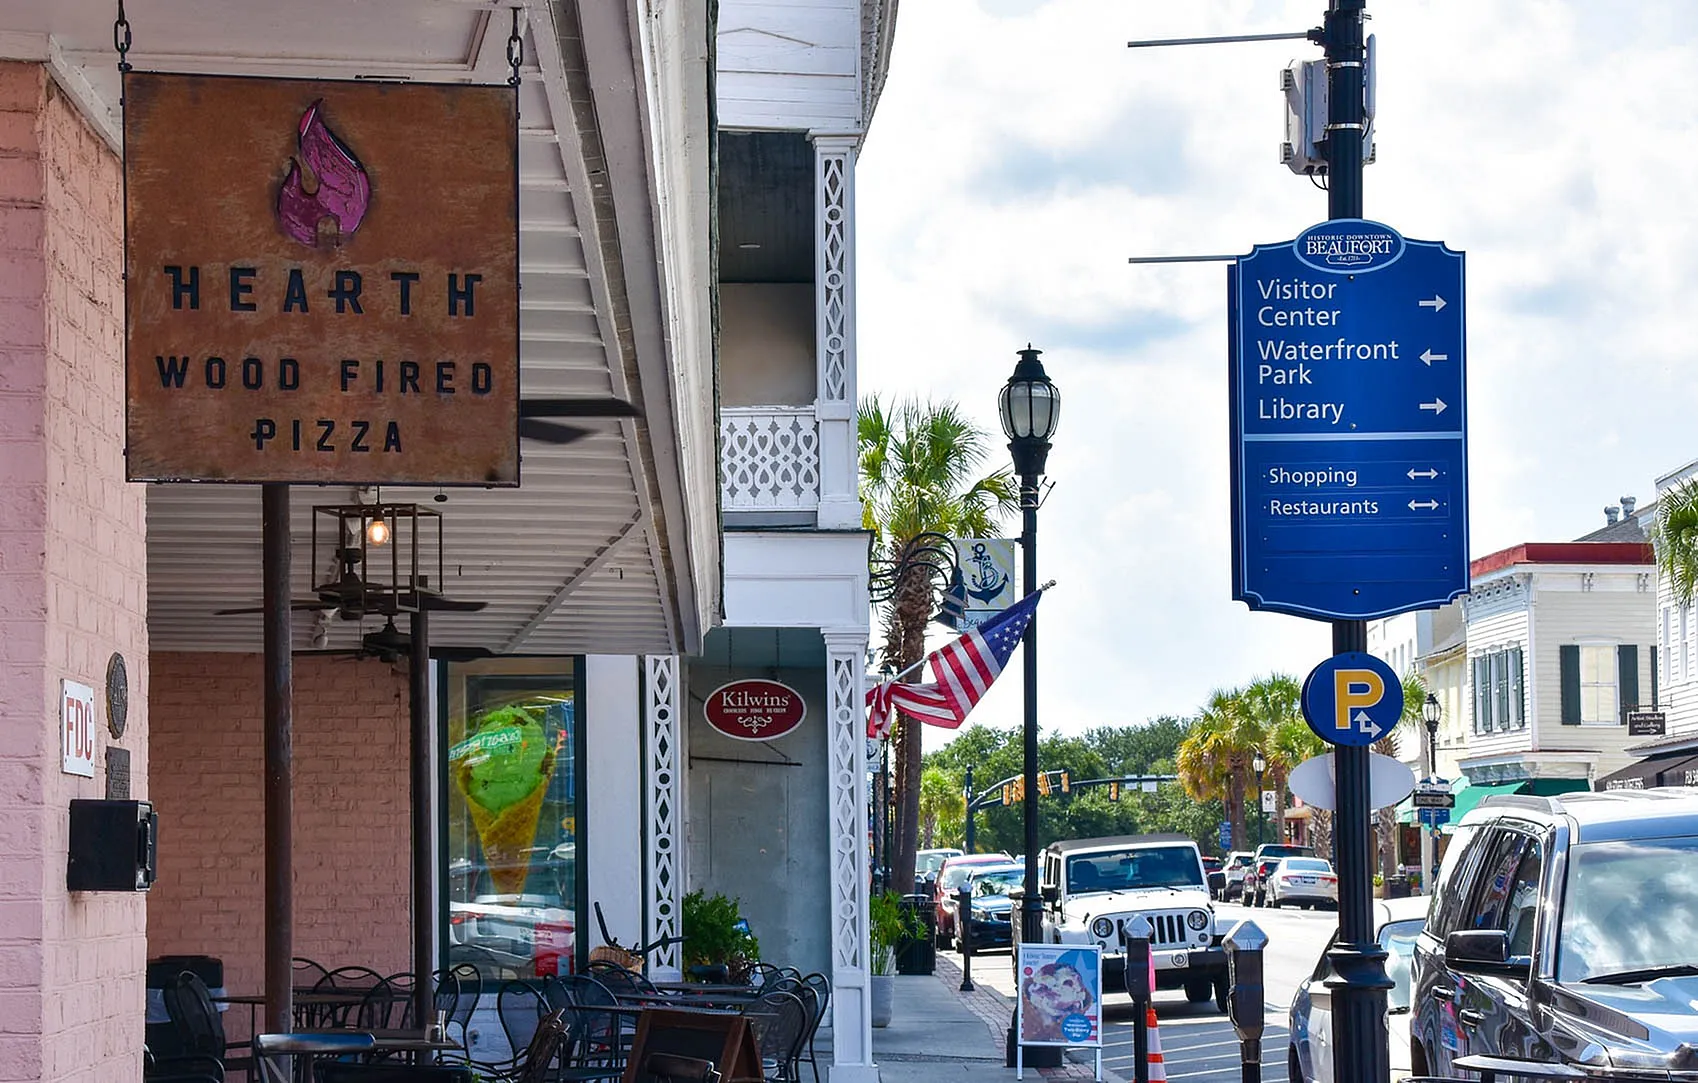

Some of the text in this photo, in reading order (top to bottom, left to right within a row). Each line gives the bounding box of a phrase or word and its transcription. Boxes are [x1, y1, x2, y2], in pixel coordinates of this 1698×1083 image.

[1306, 240, 1393, 255] BEAUFORT
[164, 264, 483, 317] HEARTH
[1257, 279, 1337, 300] Visitor
[1257, 306, 1341, 327] Center
[1257, 338, 1399, 361] Waterfront
[155, 354, 494, 395] WOOD FIRED
[1258, 363, 1313, 385] Park
[1258, 397, 1345, 424] Library
[250, 418, 403, 453] PIZZA
[1269, 466, 1357, 487] Shopping
[1270, 499, 1379, 515] Restaurants
[721, 691, 789, 706] Kilwins
[1335, 669, 1385, 729] P
[66, 697, 92, 761] FDC
